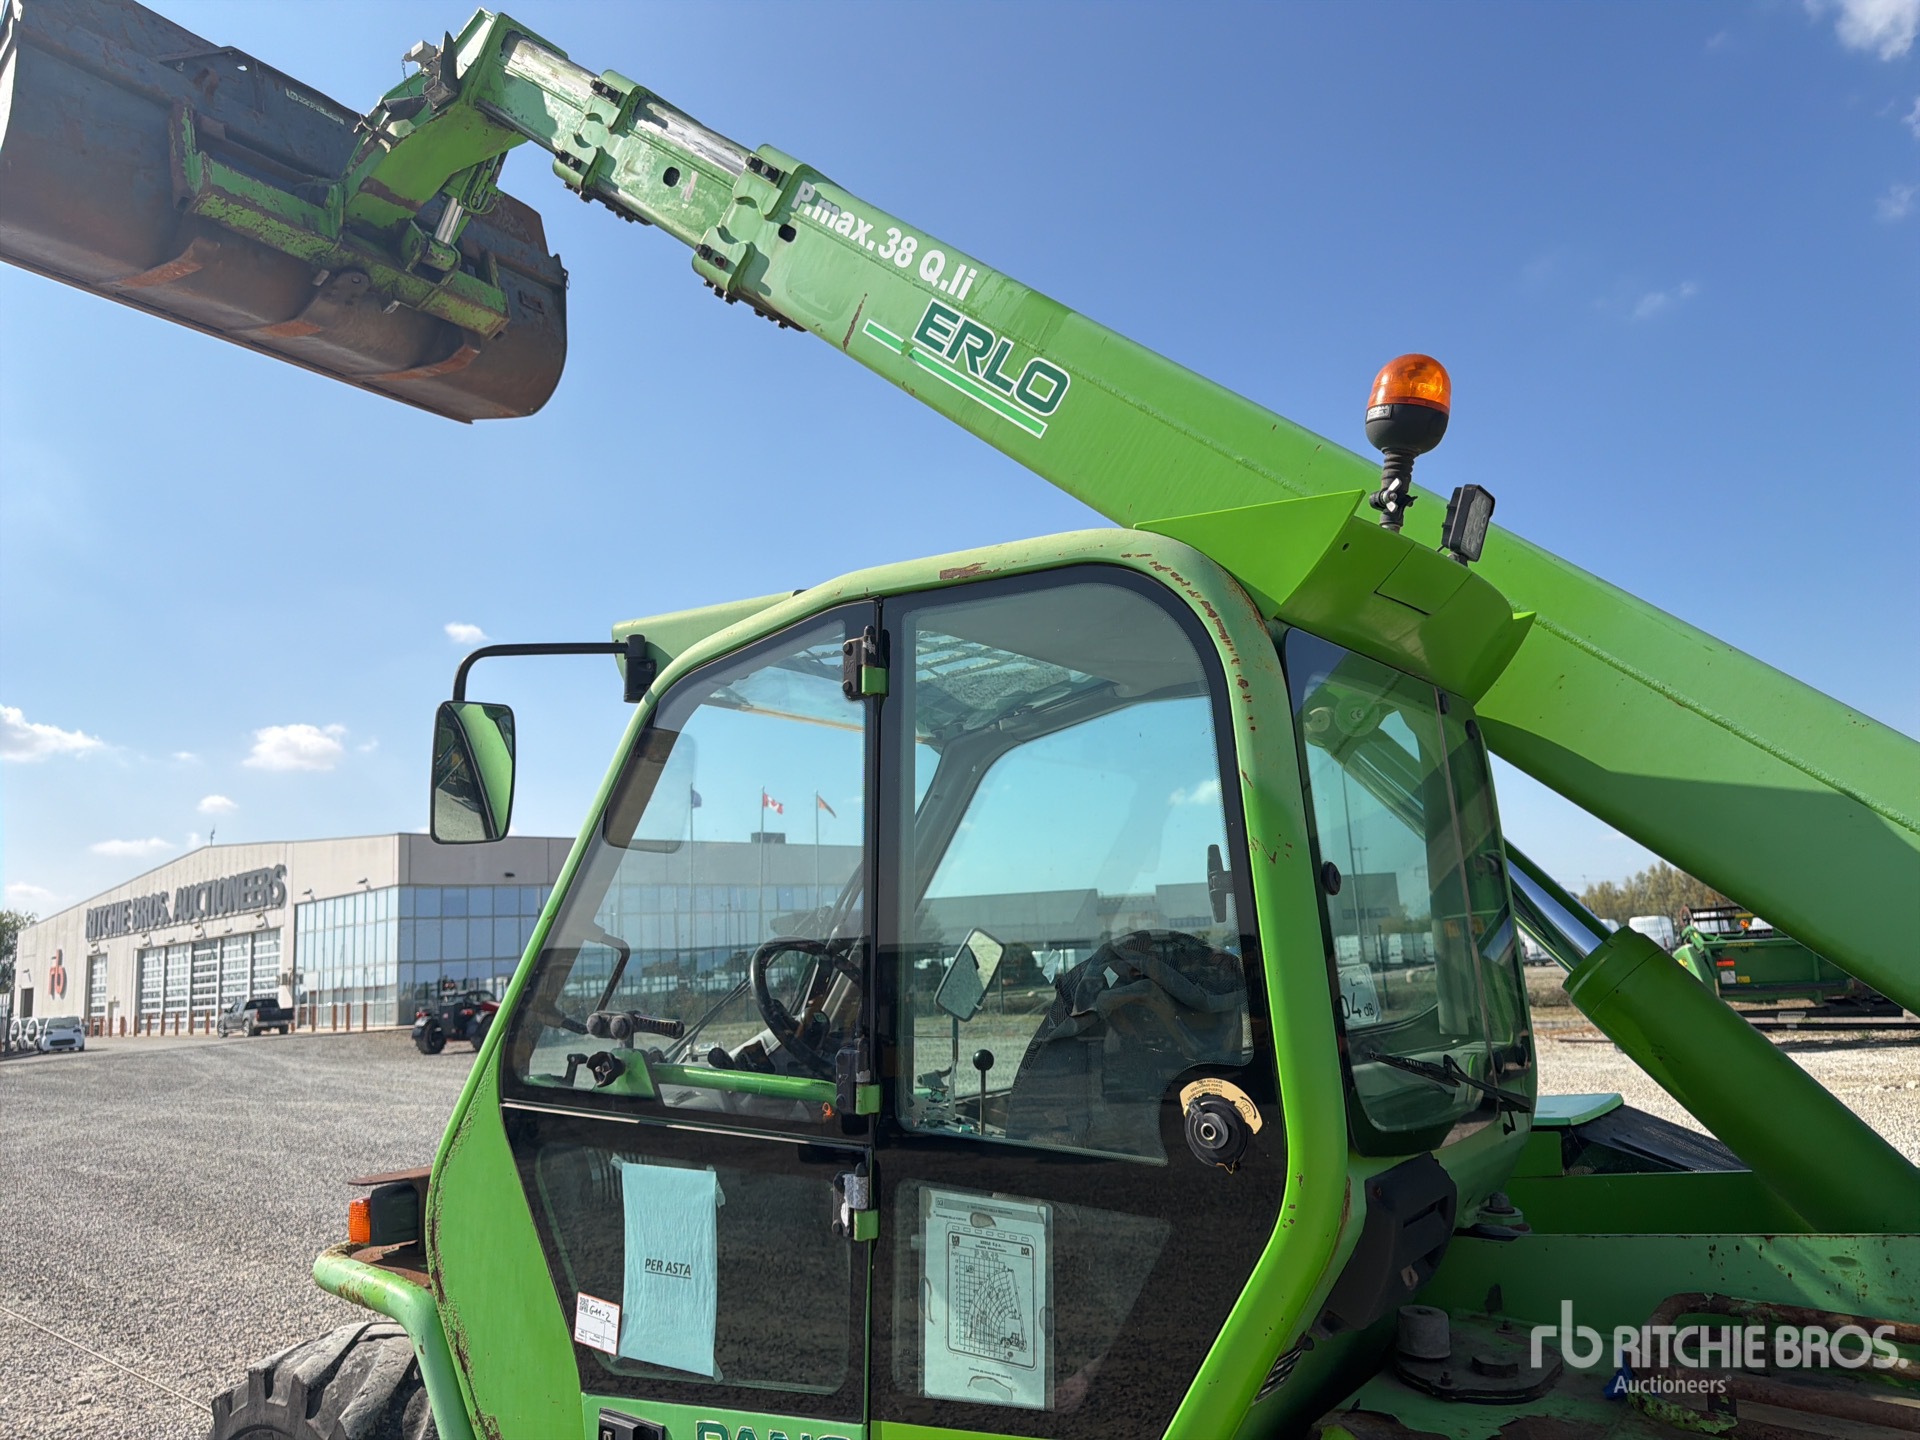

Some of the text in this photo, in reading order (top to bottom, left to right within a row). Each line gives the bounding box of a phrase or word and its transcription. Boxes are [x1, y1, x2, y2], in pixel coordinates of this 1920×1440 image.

[919, 250, 977, 301] Q.li
[911, 298, 1071, 417] ERLO
[85, 899, 132, 939] RITCHIE
[172, 864, 288, 922] AUCTIONEERS
[644, 1258, 691, 1276] PER ASTA
